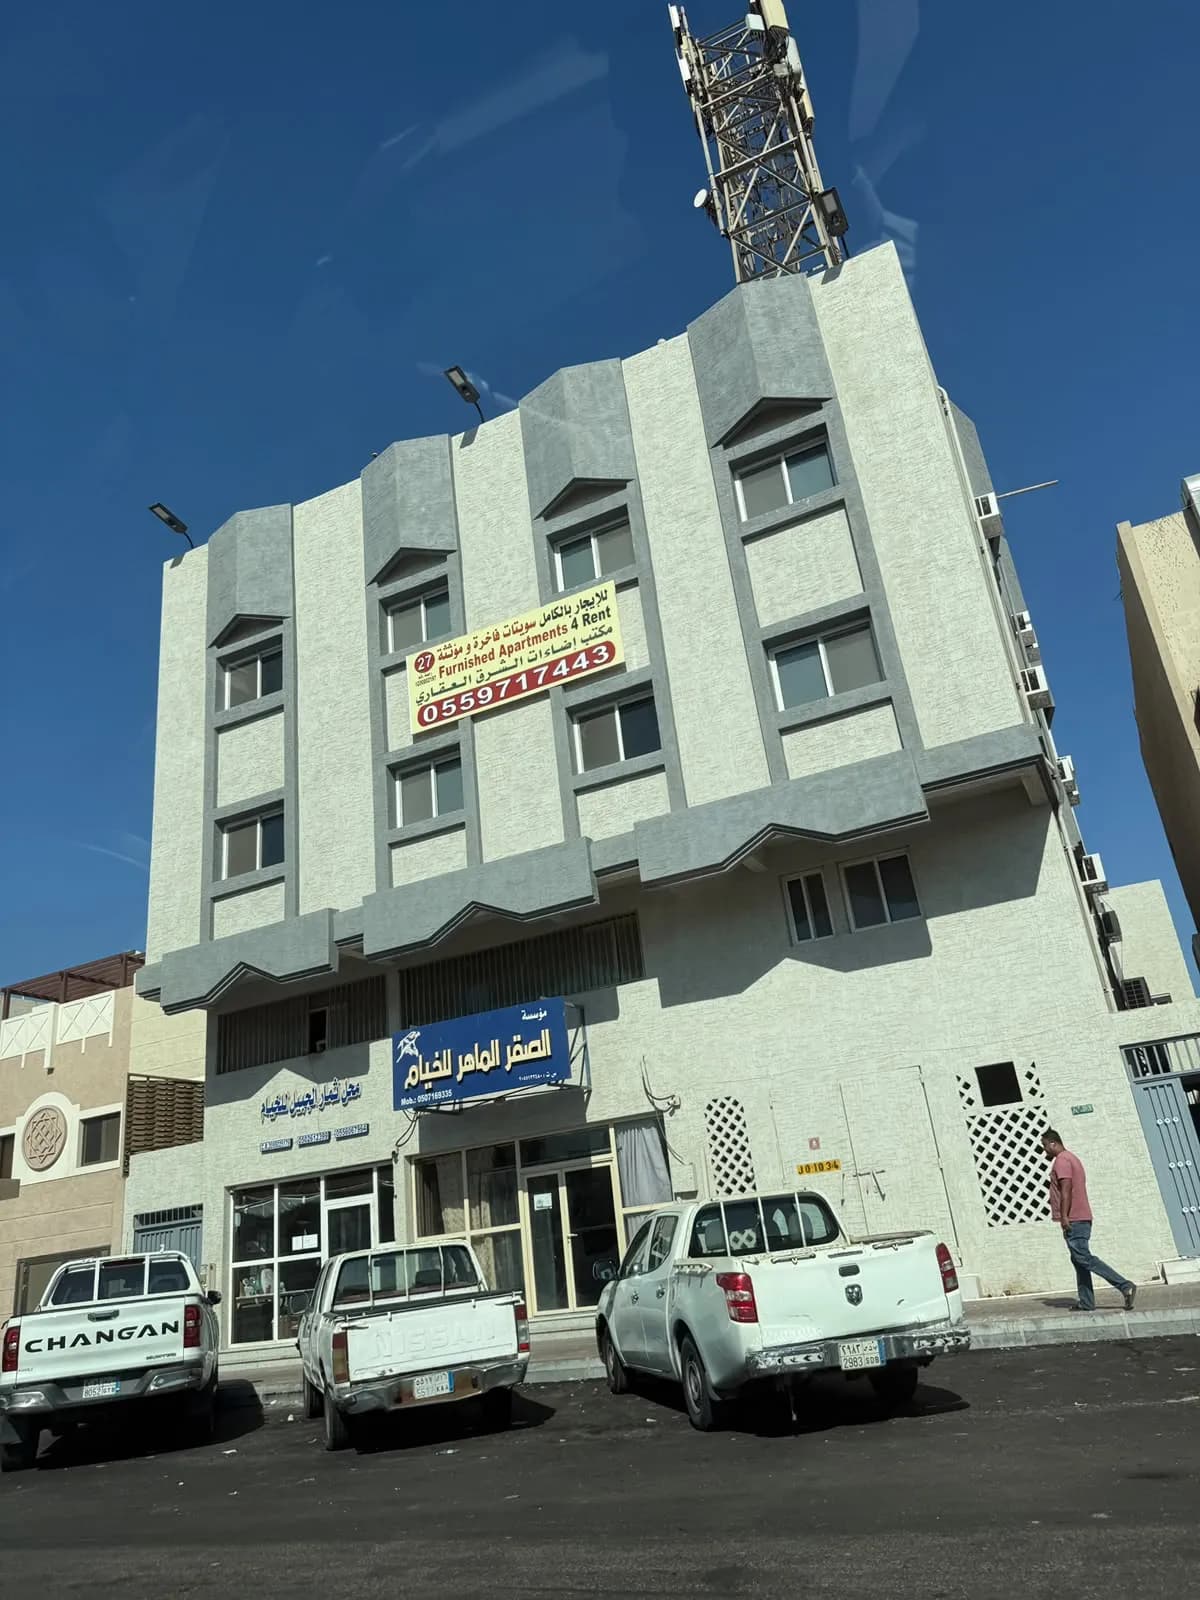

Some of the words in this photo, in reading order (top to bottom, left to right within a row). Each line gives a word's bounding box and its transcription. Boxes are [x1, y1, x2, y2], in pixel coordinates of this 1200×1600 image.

[539, 602, 572, 627] بالكامل
[575, 589, 608, 615] للإيجار
[473, 630, 500, 650] فاخرة
[502, 619, 536, 639] سويتات
[580, 625, 613, 646] مكتب
[439, 651, 495, 679] Furnished
[499, 623, 568, 658] Apartments
[571, 617, 578, 631] 4
[583, 606, 612, 627] Rent
[416, 655, 432, 671] 27
[423, 645, 610, 724] 0559717443
[521, 1007, 547, 1021] مؤسسة
[456, 1039, 500, 1083] الماهر
[505, 1028, 552, 1072] الصقر
[404, 1048, 452, 1090] للخيام
[25, 1320, 179, 1353] CHANGAN
[844, 1356, 863, 1368] 2983
